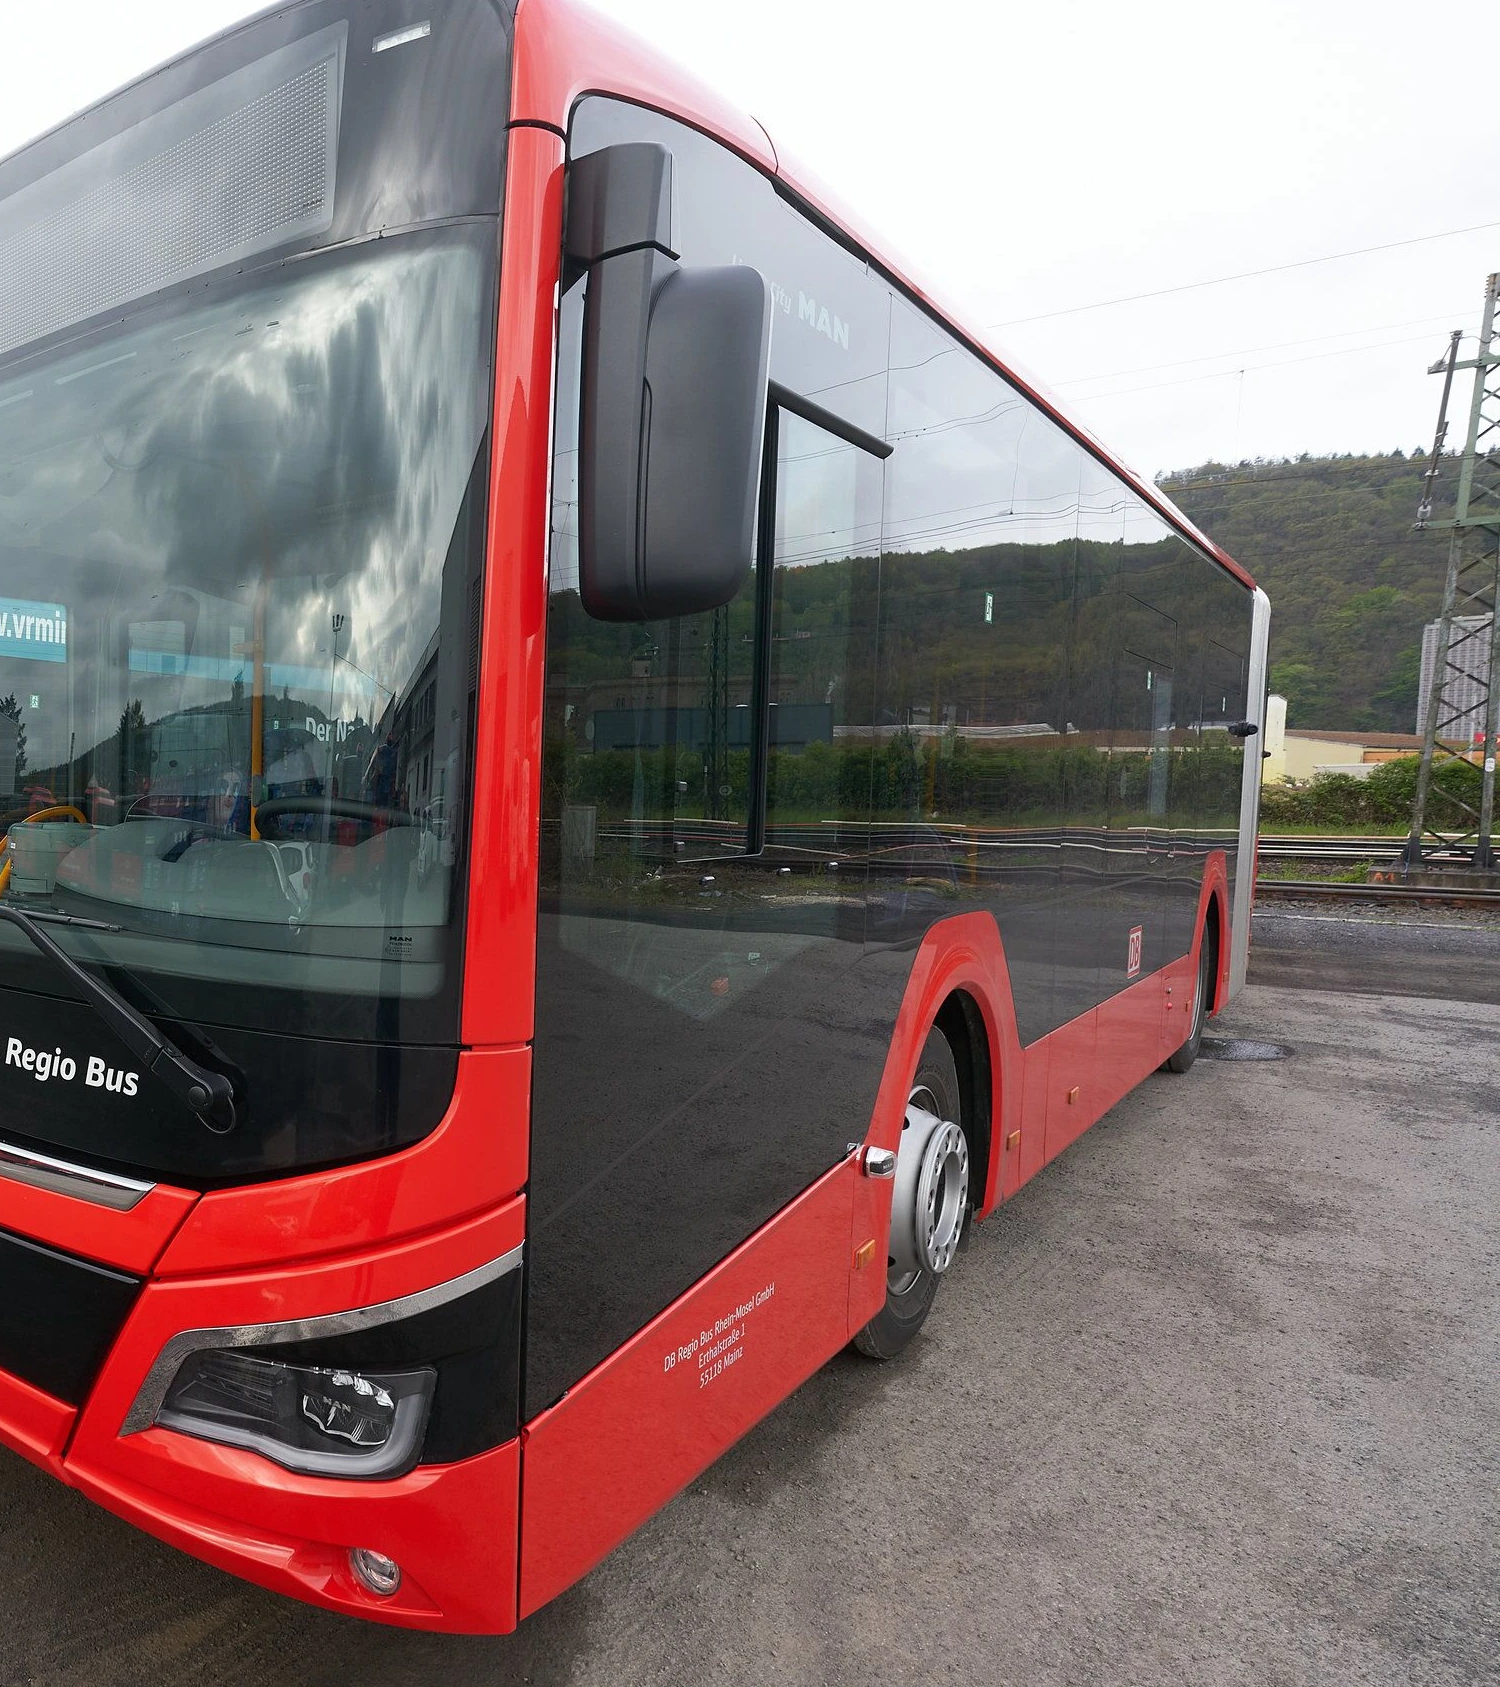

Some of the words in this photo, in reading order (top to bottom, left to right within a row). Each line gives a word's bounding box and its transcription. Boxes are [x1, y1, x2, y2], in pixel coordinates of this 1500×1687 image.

[798, 290, 849, 350] MAN
[306, 716, 332, 742] Der
[1129, 934, 1140, 969] DB
[4, 1036, 77, 1082] Regio
[84, 1055, 140, 1097] Bus
[664, 1351, 676, 1373] DB
[677, 1338, 699, 1363] Regio
[700, 1329, 714, 1348] Bus
[714, 1295, 755, 1336] Rhein-Mosel
[755, 1282, 775, 1306] GmbH
[698, 1328, 740, 1370] Erthalstraße
[740, 1322, 746, 1338] 1
[700, 1359, 723, 1390] 55118
[723, 1346, 744, 1371] Mainz
